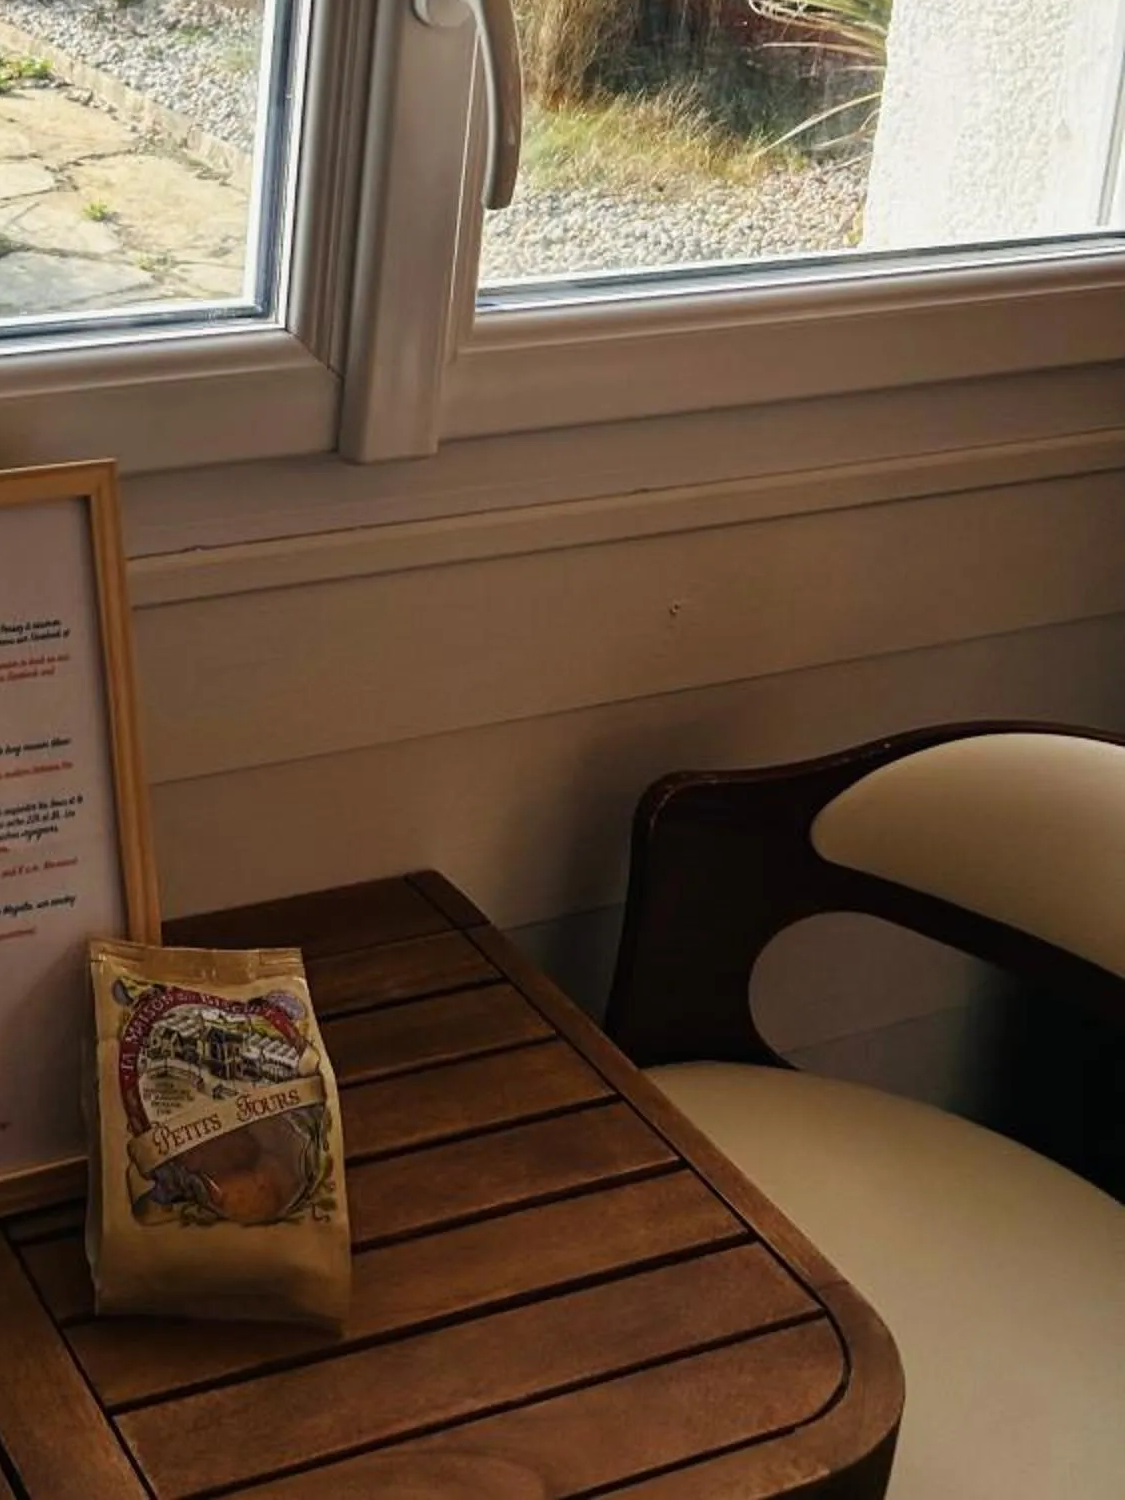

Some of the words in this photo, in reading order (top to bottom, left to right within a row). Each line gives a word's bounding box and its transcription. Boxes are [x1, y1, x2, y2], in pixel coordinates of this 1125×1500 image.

[125, 987, 174, 1044] MAISON
[153, 1113, 222, 1156] PETITS
[236, 1088, 301, 1122] FOURS
